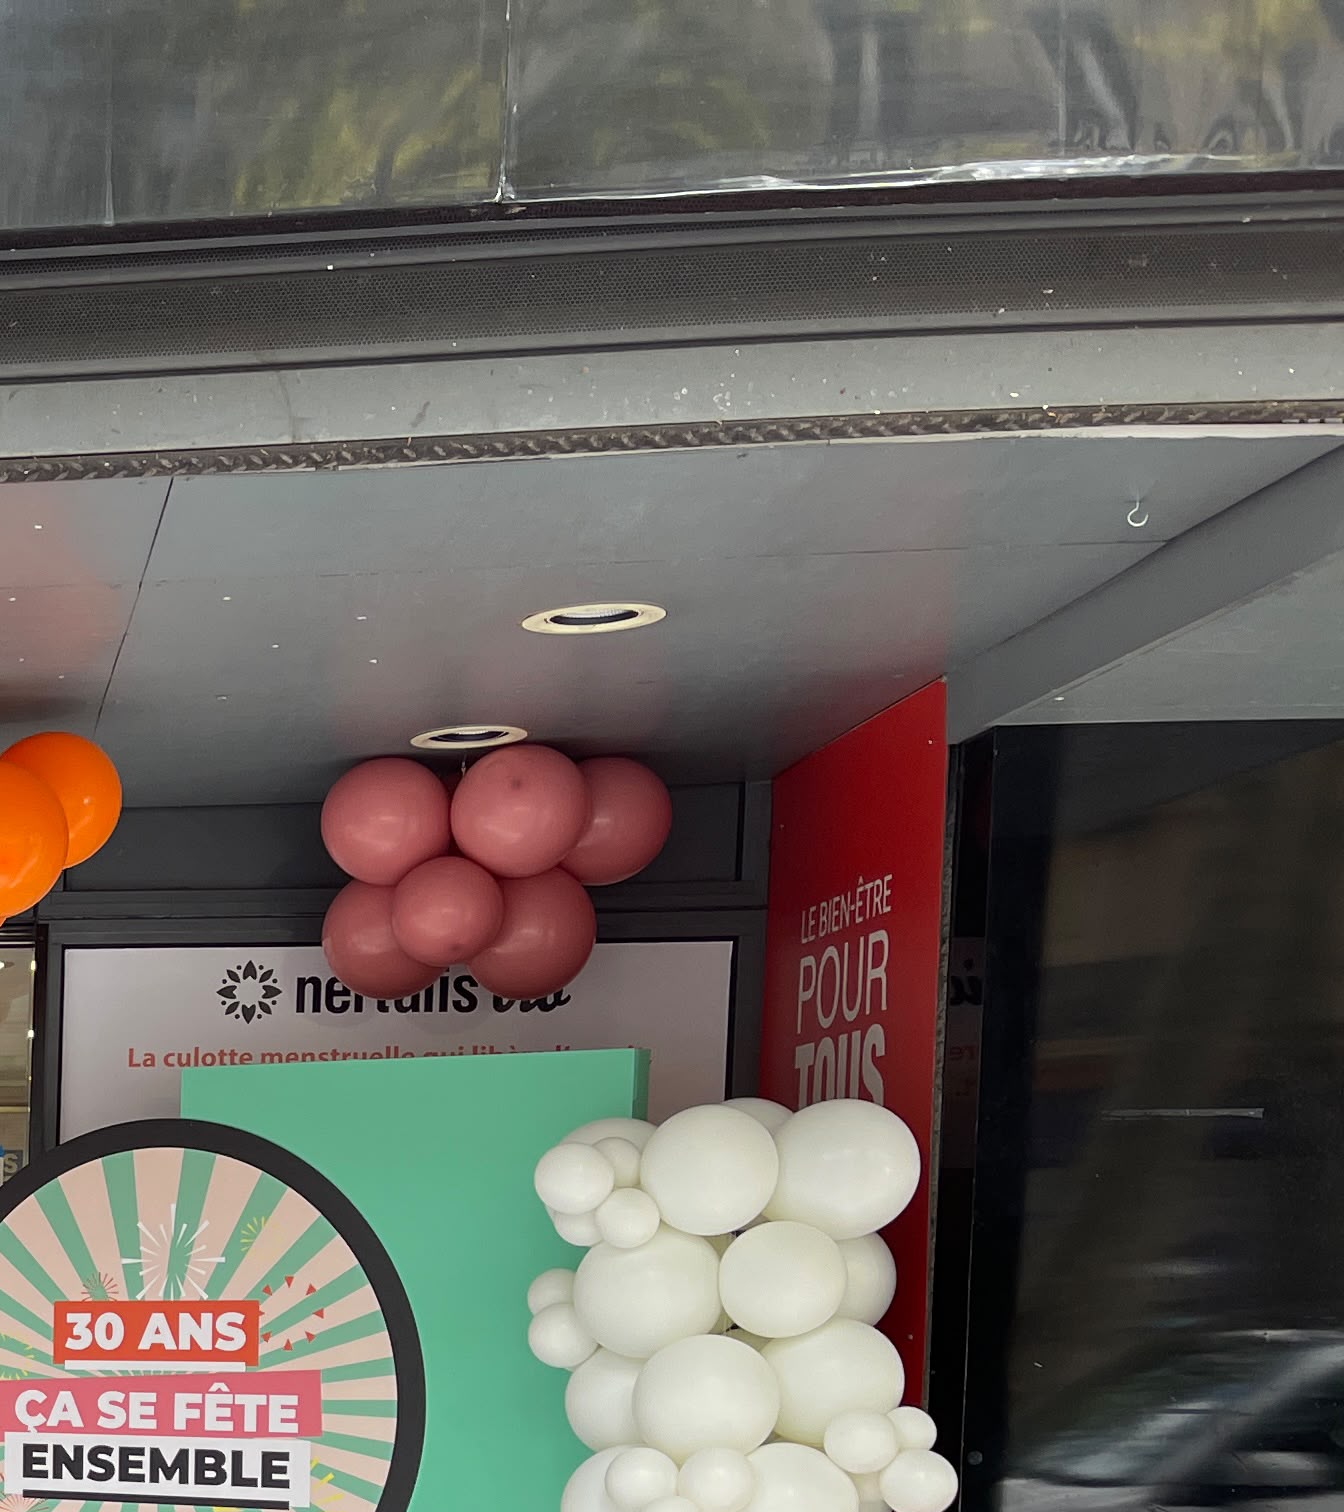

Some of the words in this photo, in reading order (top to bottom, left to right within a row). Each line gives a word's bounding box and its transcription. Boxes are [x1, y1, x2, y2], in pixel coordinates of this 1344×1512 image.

[801, 906, 816, 944] LE
[818, 874, 893, 937] BIEN-ÊTRE
[796, 929, 889, 1034] POUR
[127, 1047, 156, 1068] La
[163, 1046, 253, 1068] culotte
[794, 1023, 886, 1111] TOUS
[65, 1312, 125, 1351] 30
[137, 1311, 247, 1352] ANS
[14, 1388, 84, 1434] ÇA
[96, 1390, 158, 1430] SE
[173, 1382, 300, 1434] FÊTE
[22, 1442, 291, 1490] ENSEMBLE
